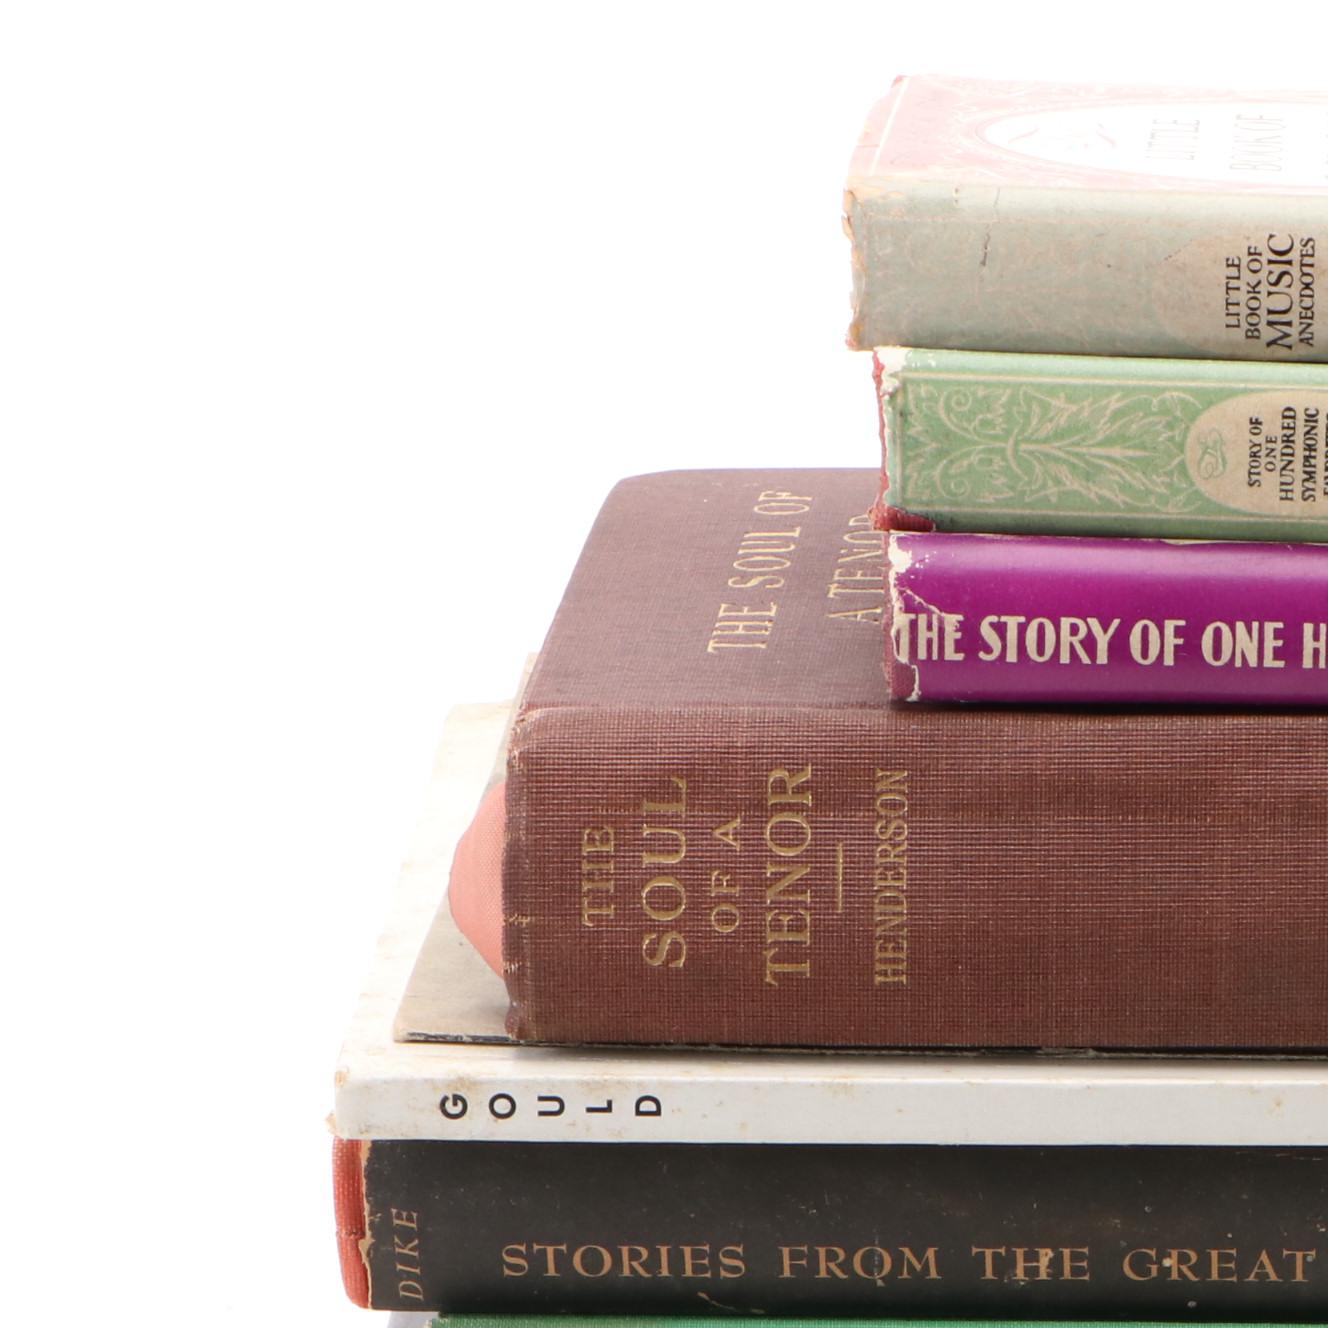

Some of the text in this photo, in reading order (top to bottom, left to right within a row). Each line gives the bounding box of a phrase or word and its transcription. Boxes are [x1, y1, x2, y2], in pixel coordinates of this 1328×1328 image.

[1225, 256, 1240, 328] LITTLE
[1245, 246, 1262, 340] BOOK OF
[1266, 233, 1294, 350] MUSIC
[1299, 238, 1315, 347] ANECDOTES
[1248, 417, 1263, 487] STORY OF
[1265, 435, 1277, 472] ONE
[1280, 407, 1296, 501] HUNDRED
[1302, 408, 1319, 502] SYMPHONIC
[707, 490, 812, 653] THE SOUL OF
[826, 606, 882, 624] A
[895, 613, 965, 661] THE
[978, 615, 1122, 665] STORY
[1129, 619, 1186, 667] OF
[1201, 621, 1286, 669] ONE
[581, 824, 615, 927] THE
[641, 776, 687, 968] SOUL
[710, 813, 741, 933] OF A
[762, 763, 812, 986] TENOR
[874, 767, 908, 986] HENDERSON
[440, 1093, 661, 1119] GOULD
[390, 1208, 424, 1301] DIKE
[502, 1244, 747, 1282] STORIES
[780, 1246, 944, 1280] FROM
[972, 1247, 1091, 1282] THE
[1122, 1248, 1315, 1282] GREAT
